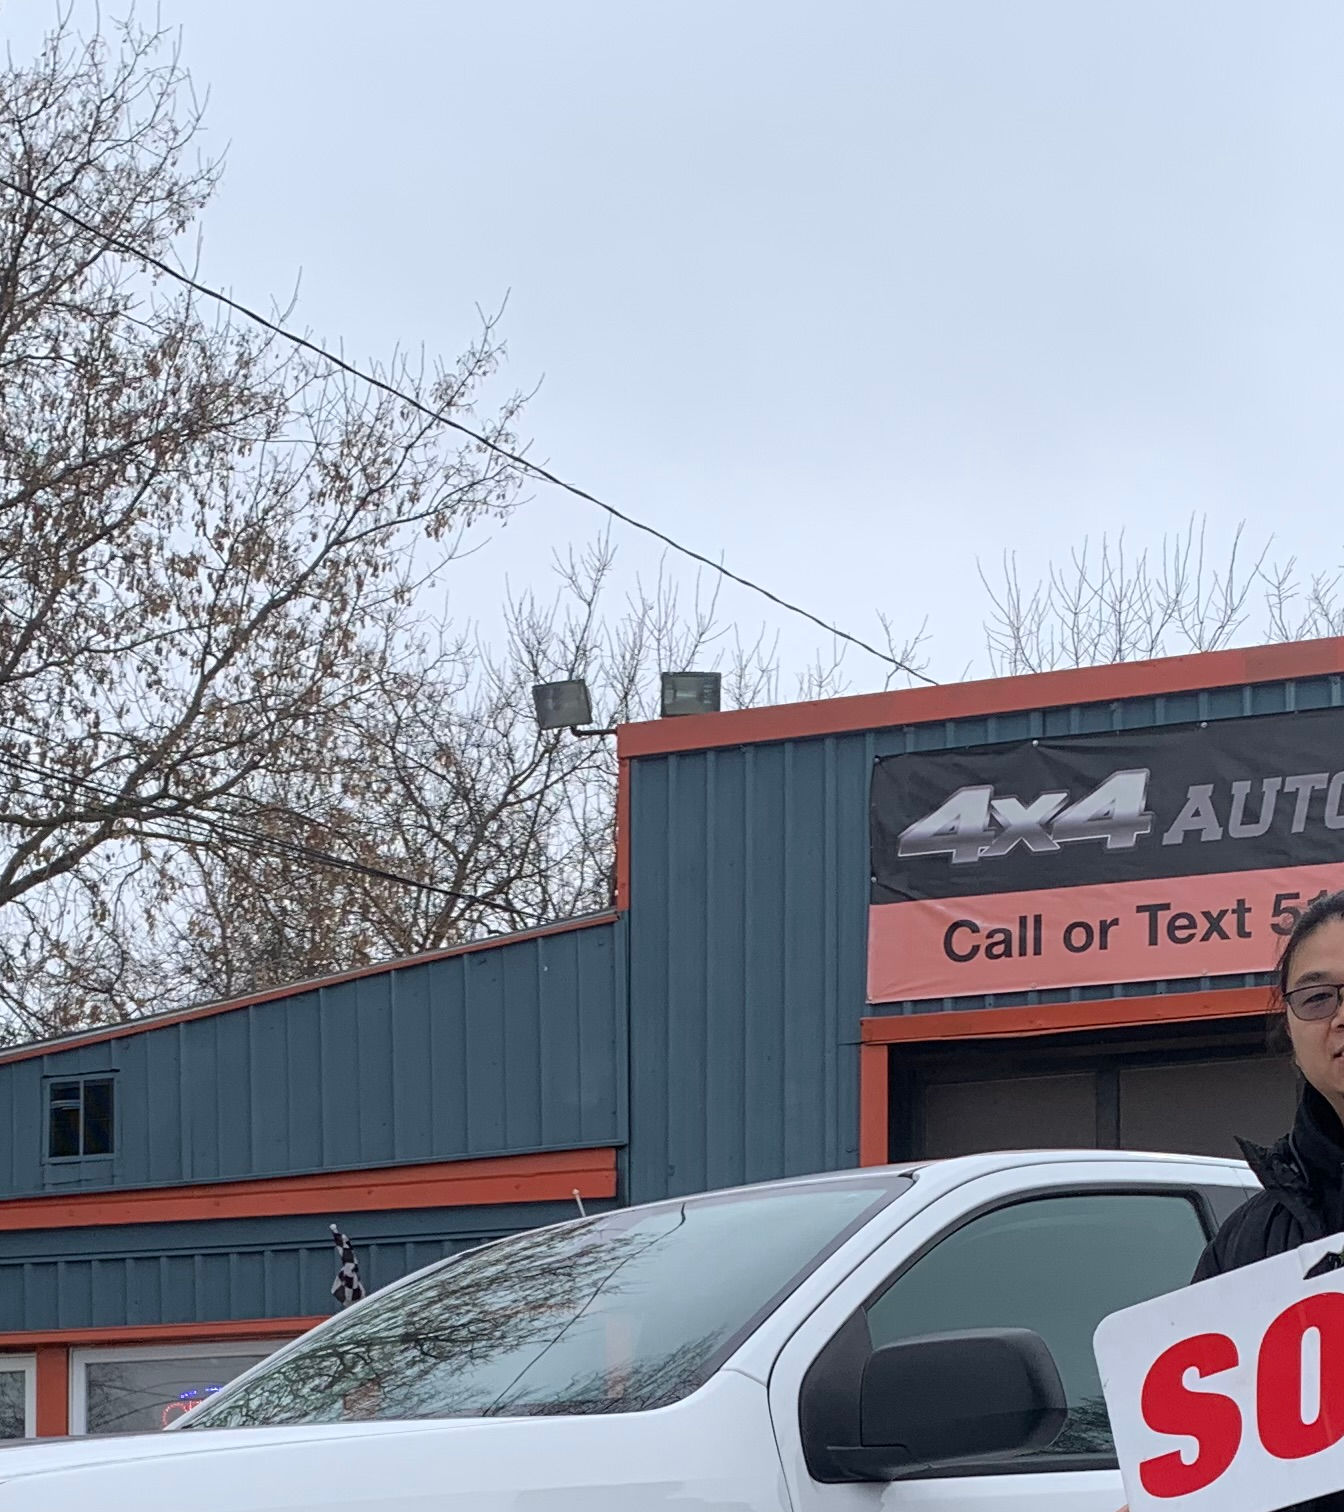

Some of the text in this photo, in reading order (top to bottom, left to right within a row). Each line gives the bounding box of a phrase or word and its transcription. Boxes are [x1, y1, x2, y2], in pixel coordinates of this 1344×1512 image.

[897, 768, 1154, 864] 4x4
[943, 914, 1042, 963] Call
[1062, 916, 1120, 954] or
[1135, 897, 1253, 948] Text
